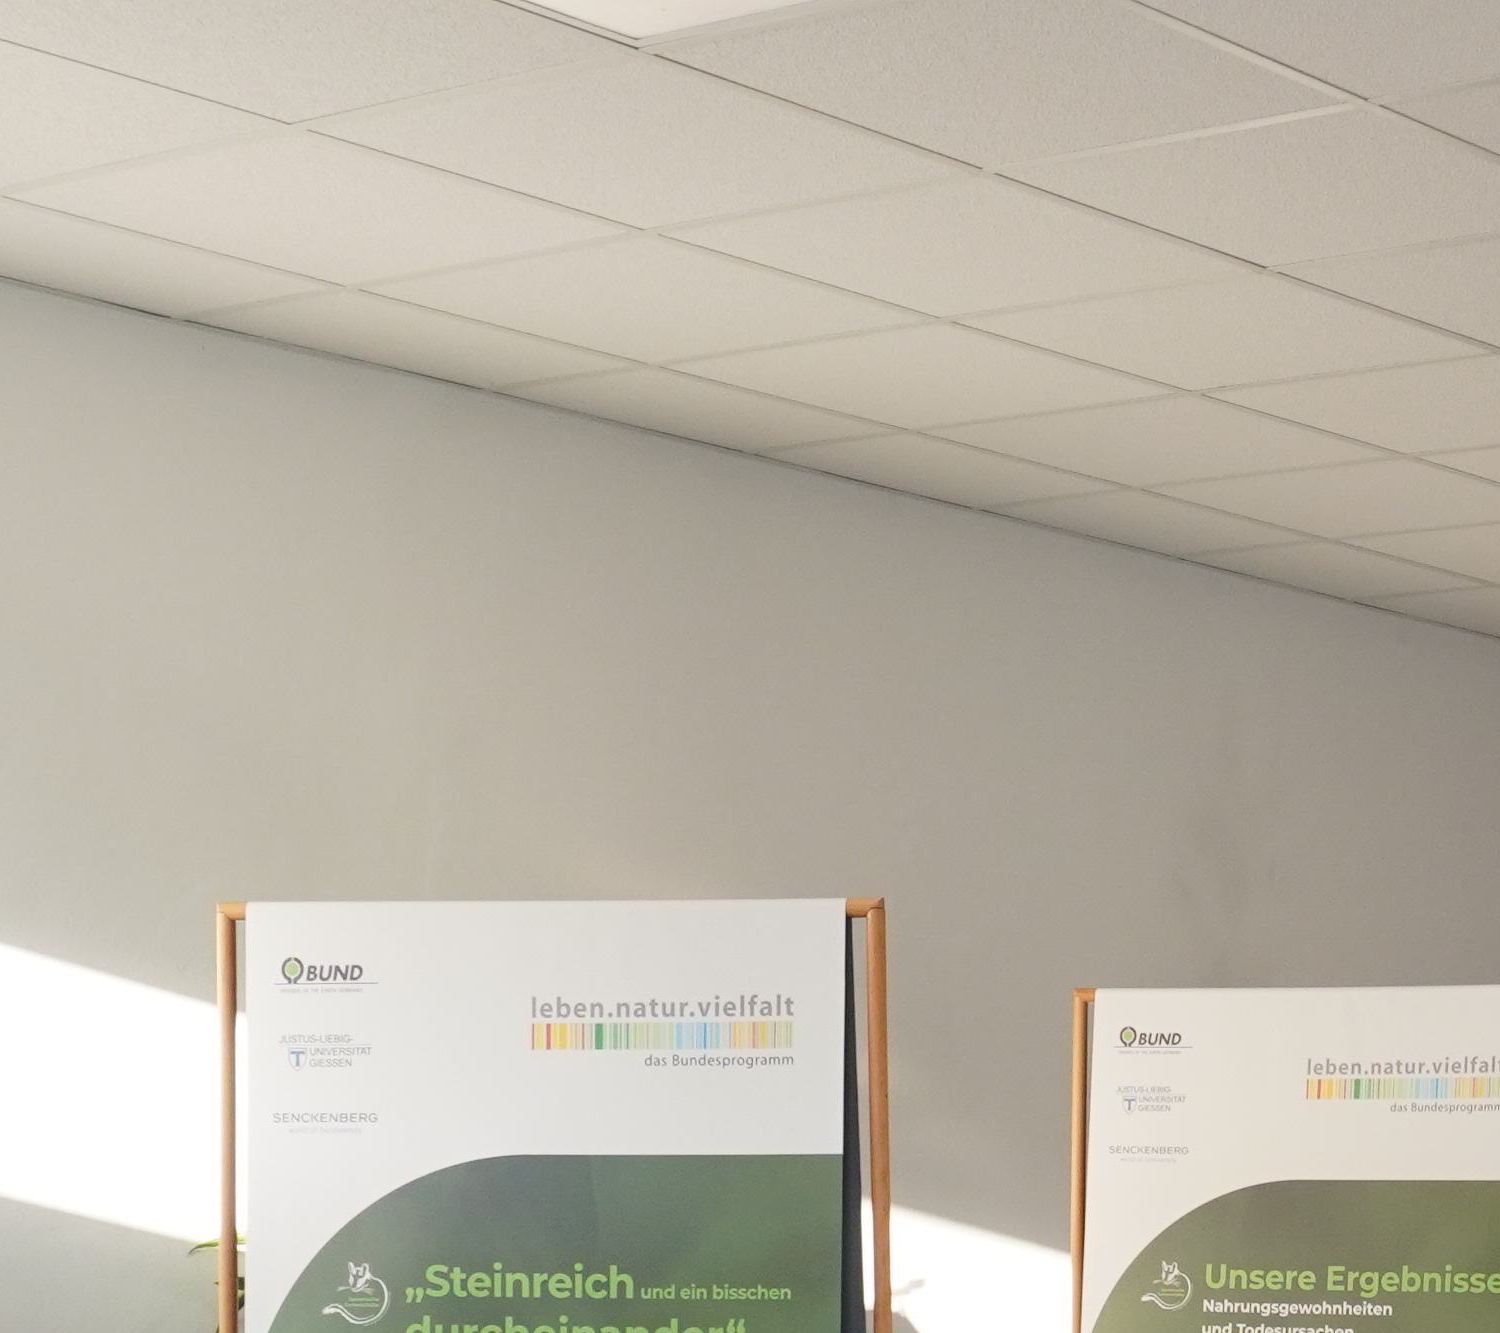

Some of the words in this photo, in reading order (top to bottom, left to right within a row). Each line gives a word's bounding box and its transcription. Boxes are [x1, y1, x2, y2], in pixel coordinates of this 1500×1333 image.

[306, 965, 363, 982] BUND
[531, 995, 795, 1019] leben.natur.vielfalt
[279, 1034, 353, 1044] JUSTUS-LIEBIG-
[1138, 1032, 1182, 1046] BUND
[309, 1059, 352, 1067] GIESSEN
[644, 1054, 668, 1067] das
[672, 1053, 795, 1069] Bundesprogramm
[1390, 1102, 1407, 1112] das
[273, 1112, 378, 1123] SENCKENBERG
[1109, 1146, 1189, 1155] SENCKENBERG
[1205, 1263, 1317, 1290] Unsere
[640, 1284, 675, 1301] und
[679, 1285, 707, 1301] ein
[712, 1284, 792, 1302] bisschen
[1202, 1299, 1393, 1317] Nahrungsgewohnheiten
